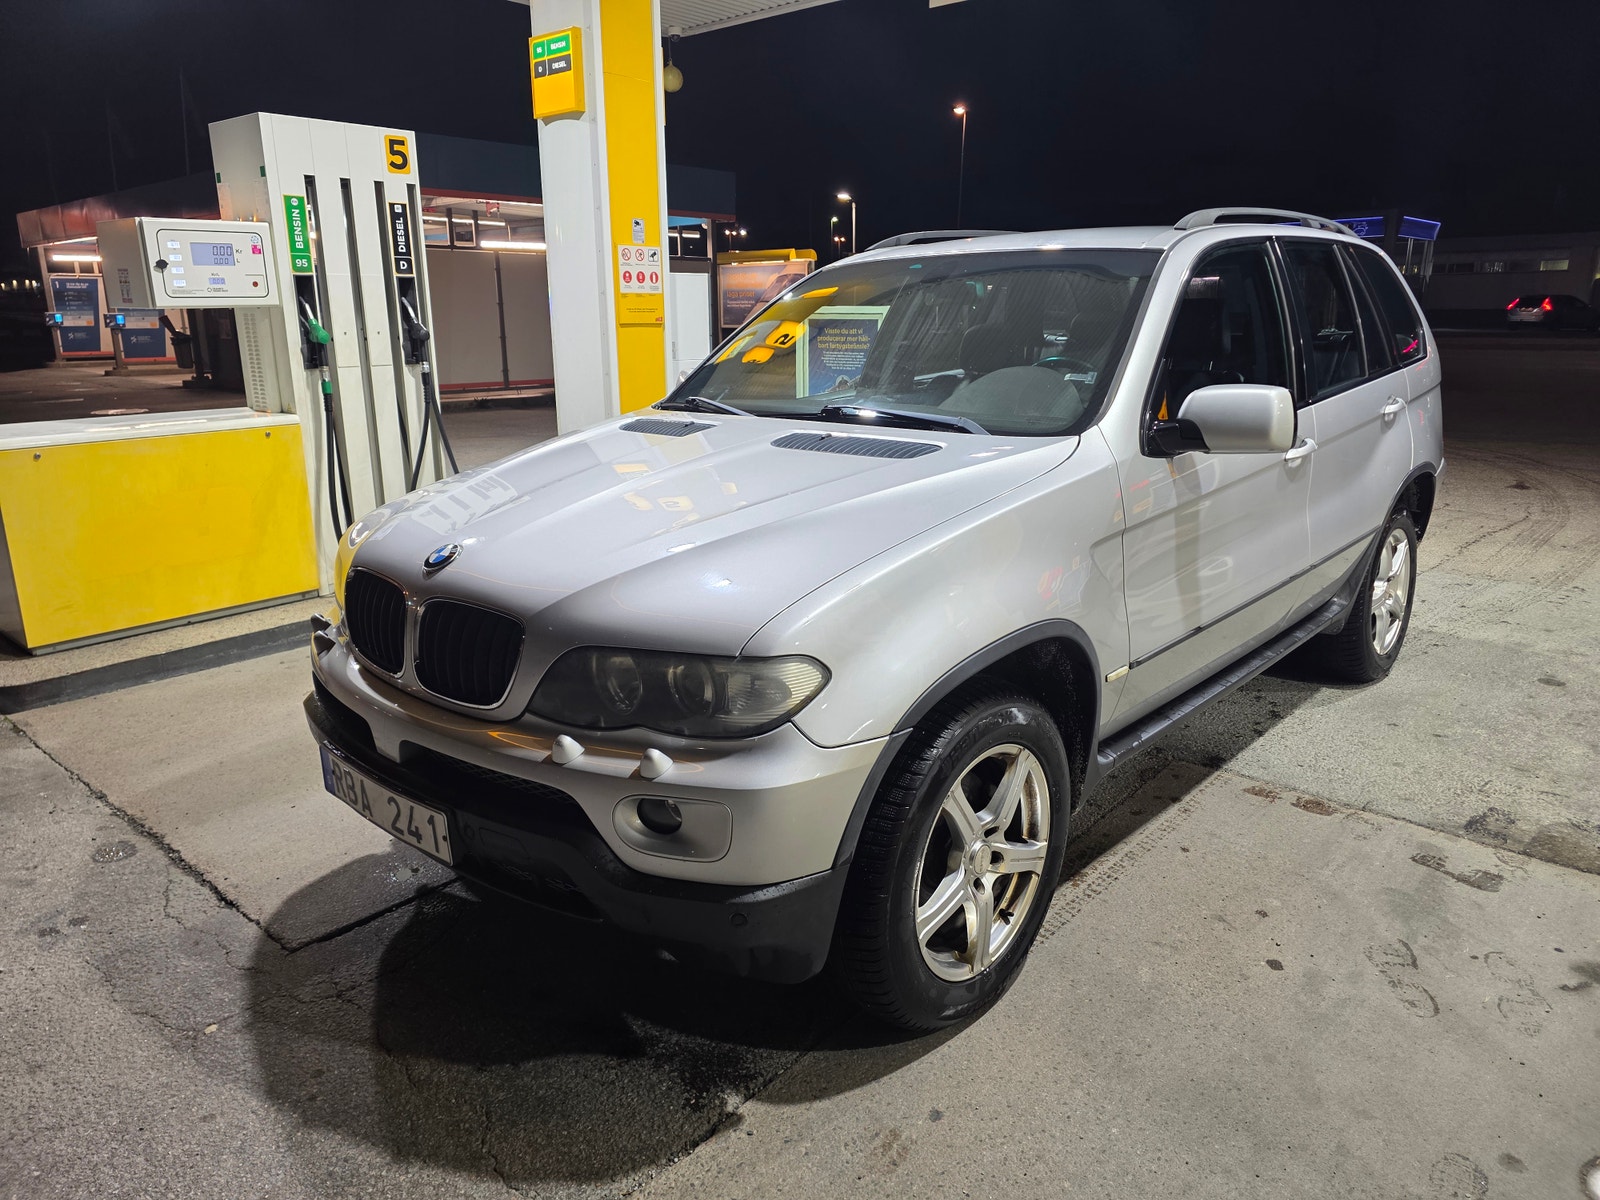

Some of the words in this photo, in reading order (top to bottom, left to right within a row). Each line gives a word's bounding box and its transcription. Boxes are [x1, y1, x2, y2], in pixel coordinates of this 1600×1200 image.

[550, 40, 566, 50] BENSIN
[551, 60, 567, 69] DIESEL
[388, 138, 408, 170] 5
[292, 208, 304, 249] BENSIN
[396, 217, 407, 252] DIESEL
[296, 259, 308, 267] 95
[399, 261, 408, 269] D
[331, 758, 373, 818] RBA
[387, 796, 440, 854] 241
